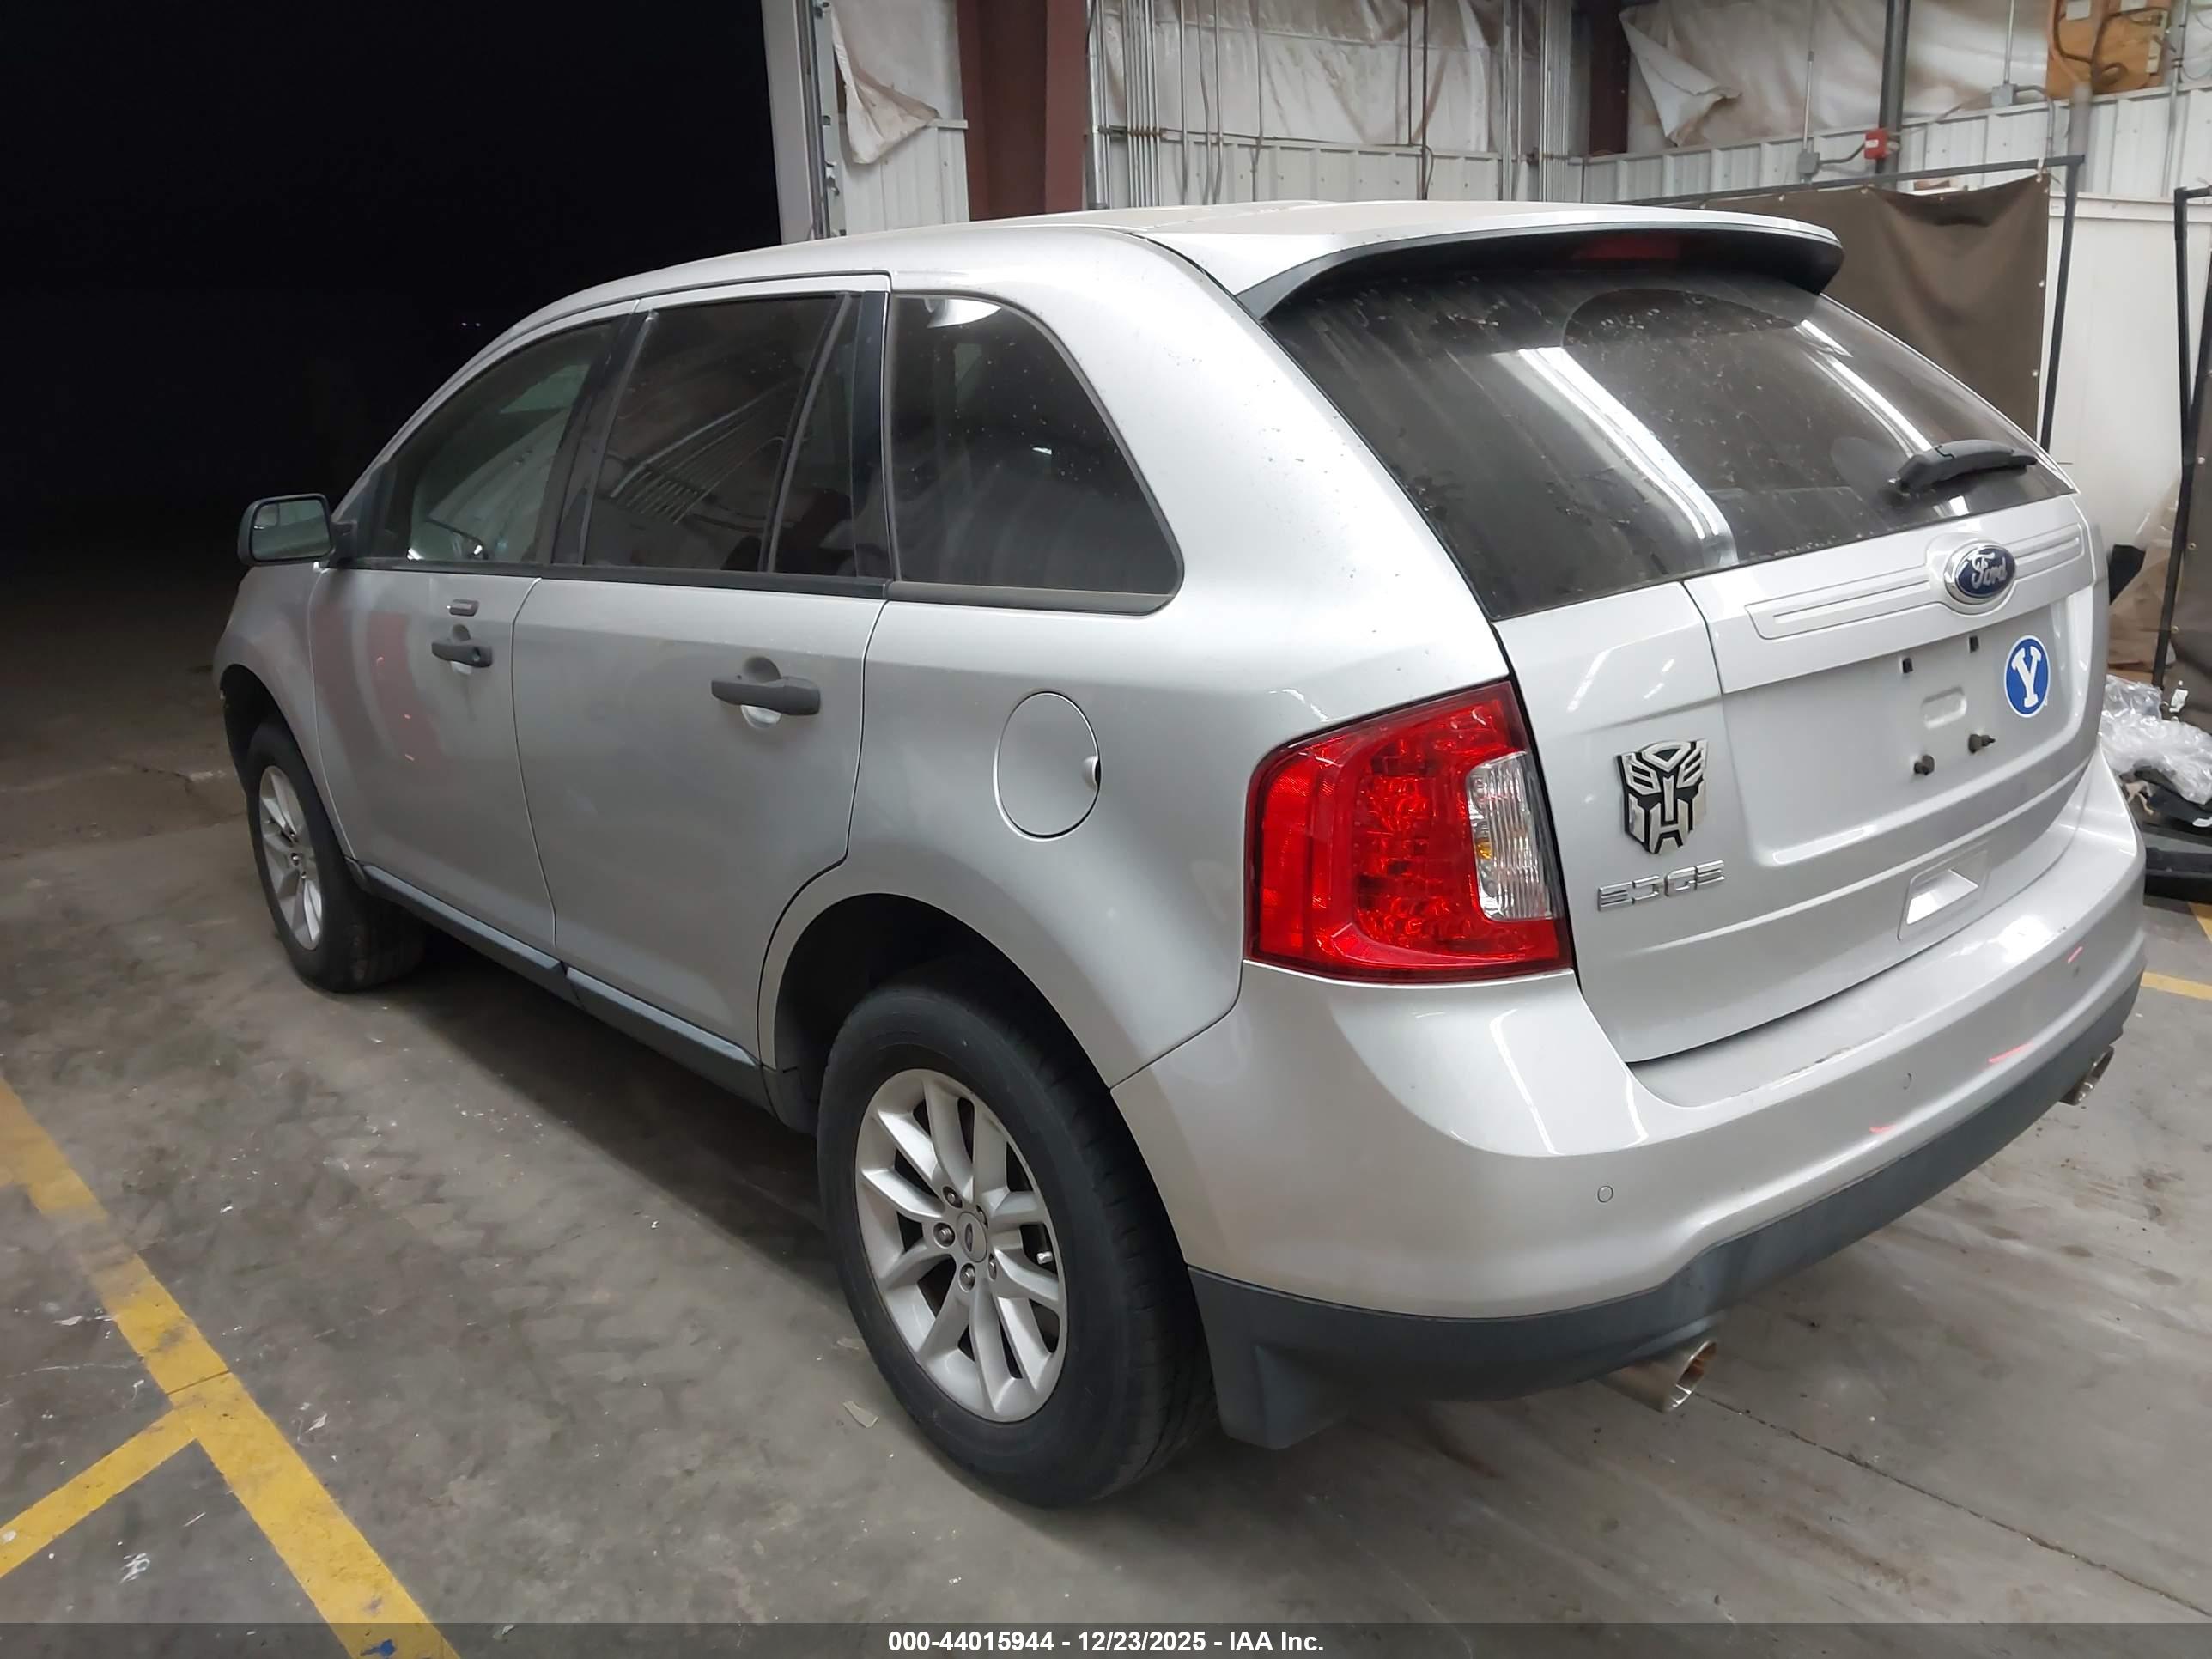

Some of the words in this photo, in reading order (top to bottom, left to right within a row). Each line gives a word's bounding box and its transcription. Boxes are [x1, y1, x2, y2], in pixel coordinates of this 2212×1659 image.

[1967, 552, 2008, 589] Ford
[2011, 646, 2042, 708] Y
[1597, 860, 1725, 912] EDGE
